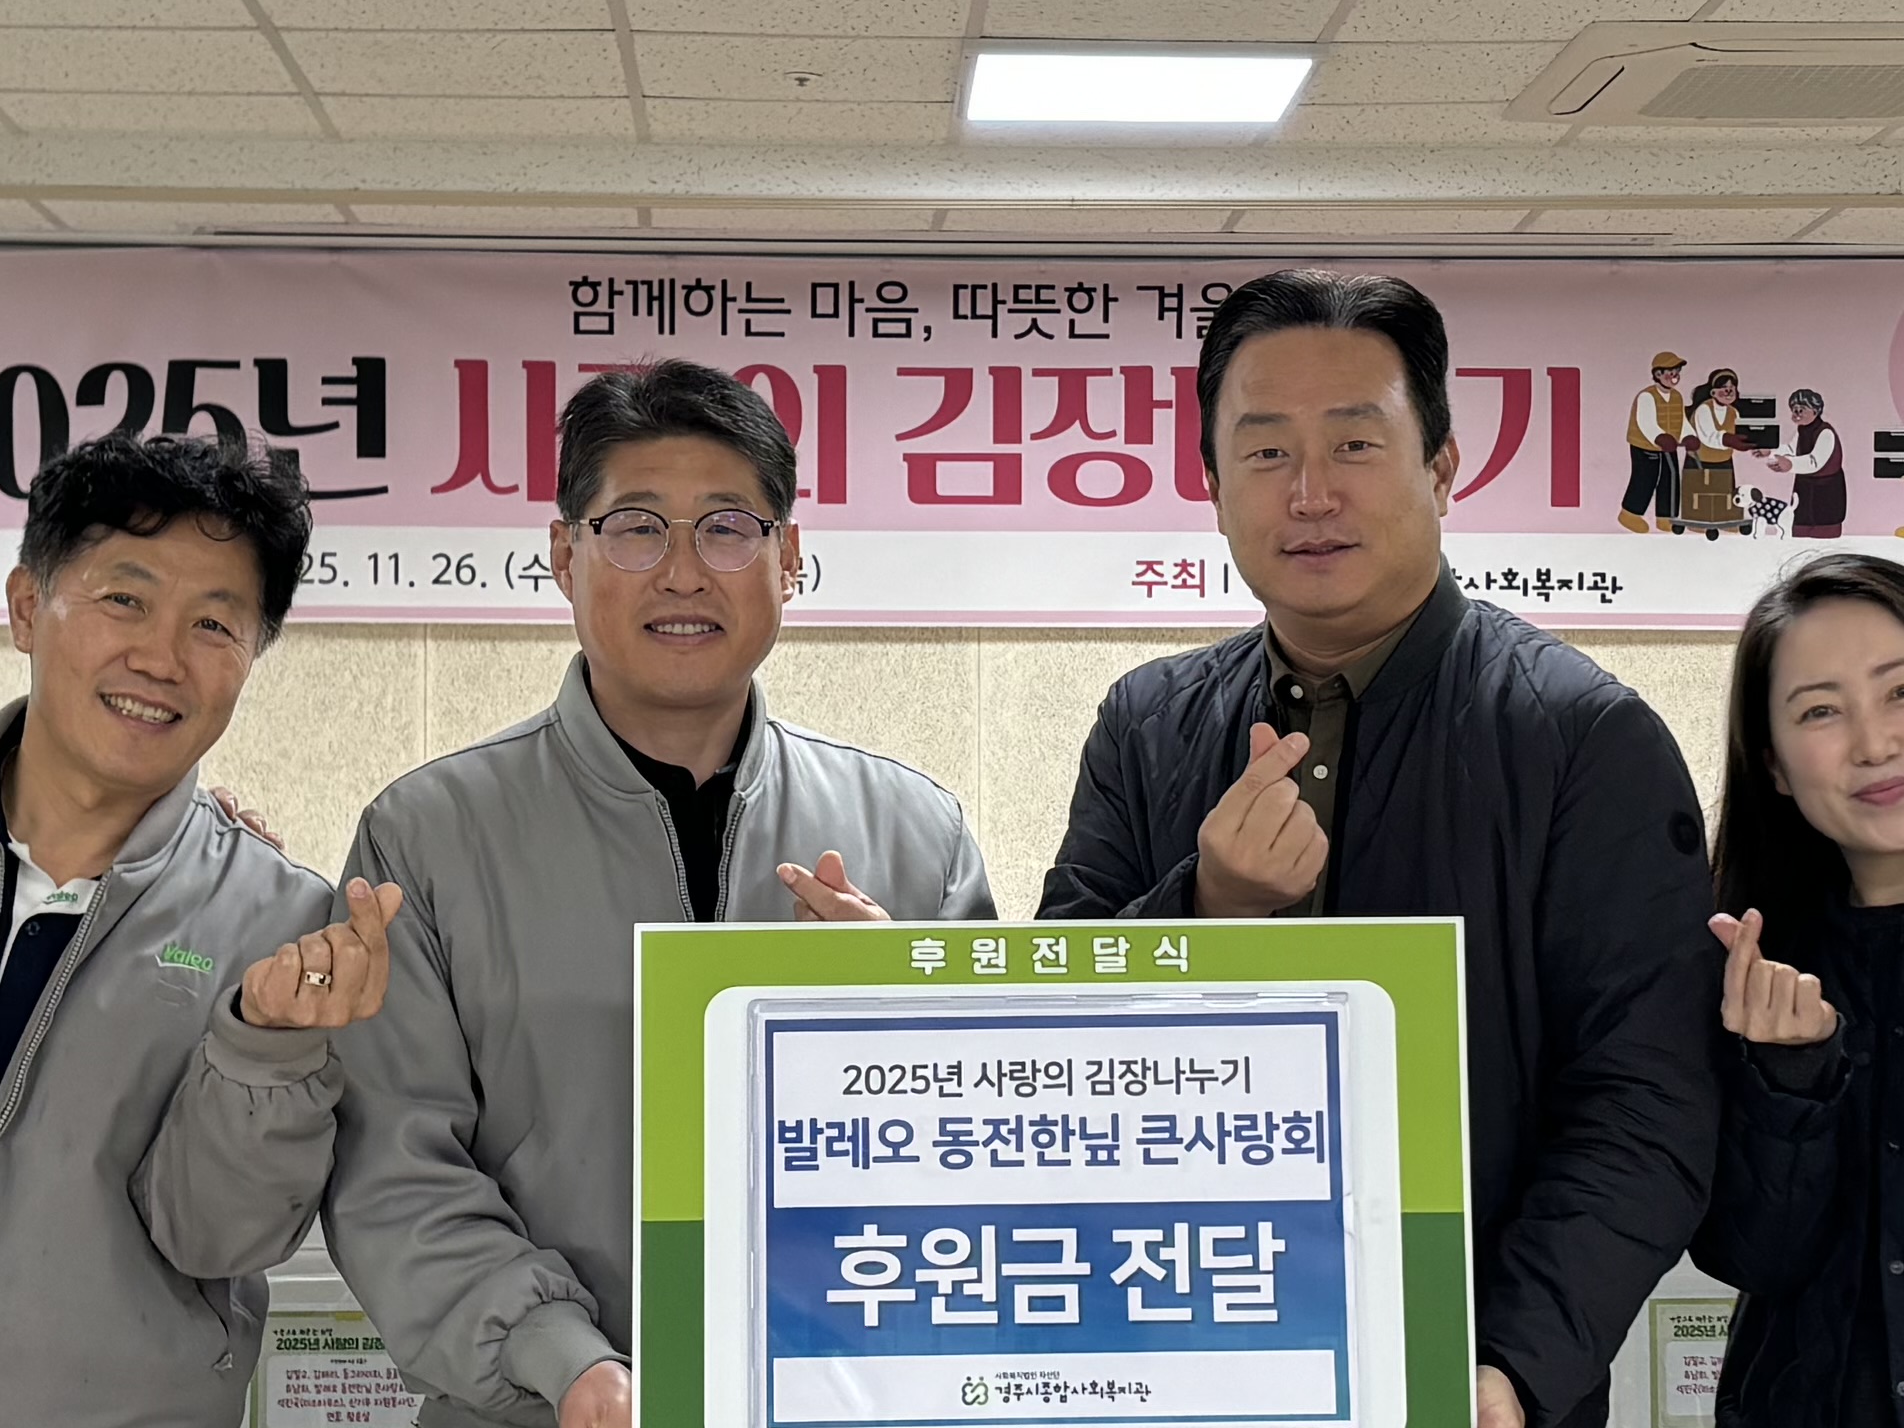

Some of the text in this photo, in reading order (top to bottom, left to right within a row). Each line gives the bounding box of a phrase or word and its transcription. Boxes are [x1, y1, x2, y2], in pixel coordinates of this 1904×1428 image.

[568, 275, 792, 337] 함께하는
[810, 280, 933, 343] 마음,
[952, 281, 1119, 340] 따뜻한
[430, 359, 847, 504] 사의
[367, 551, 416, 587] 11.
[431, 552, 487, 588] 26.
[1131, 558, 1207, 597] 주최
[1453, 567, 1624, 604] 사회복지관
[163, 942, 214, 972] Valeo
[842, 1056, 1253, 1099] 2025년 사랑의 김장나누기
[777, 1109, 1326, 1173] 발레오 동전한닢 큰사랑회
[825, 1220, 1287, 1329] 후원금 전달
[995, 1380, 1152, 1403] 경주시종합사회복지관
